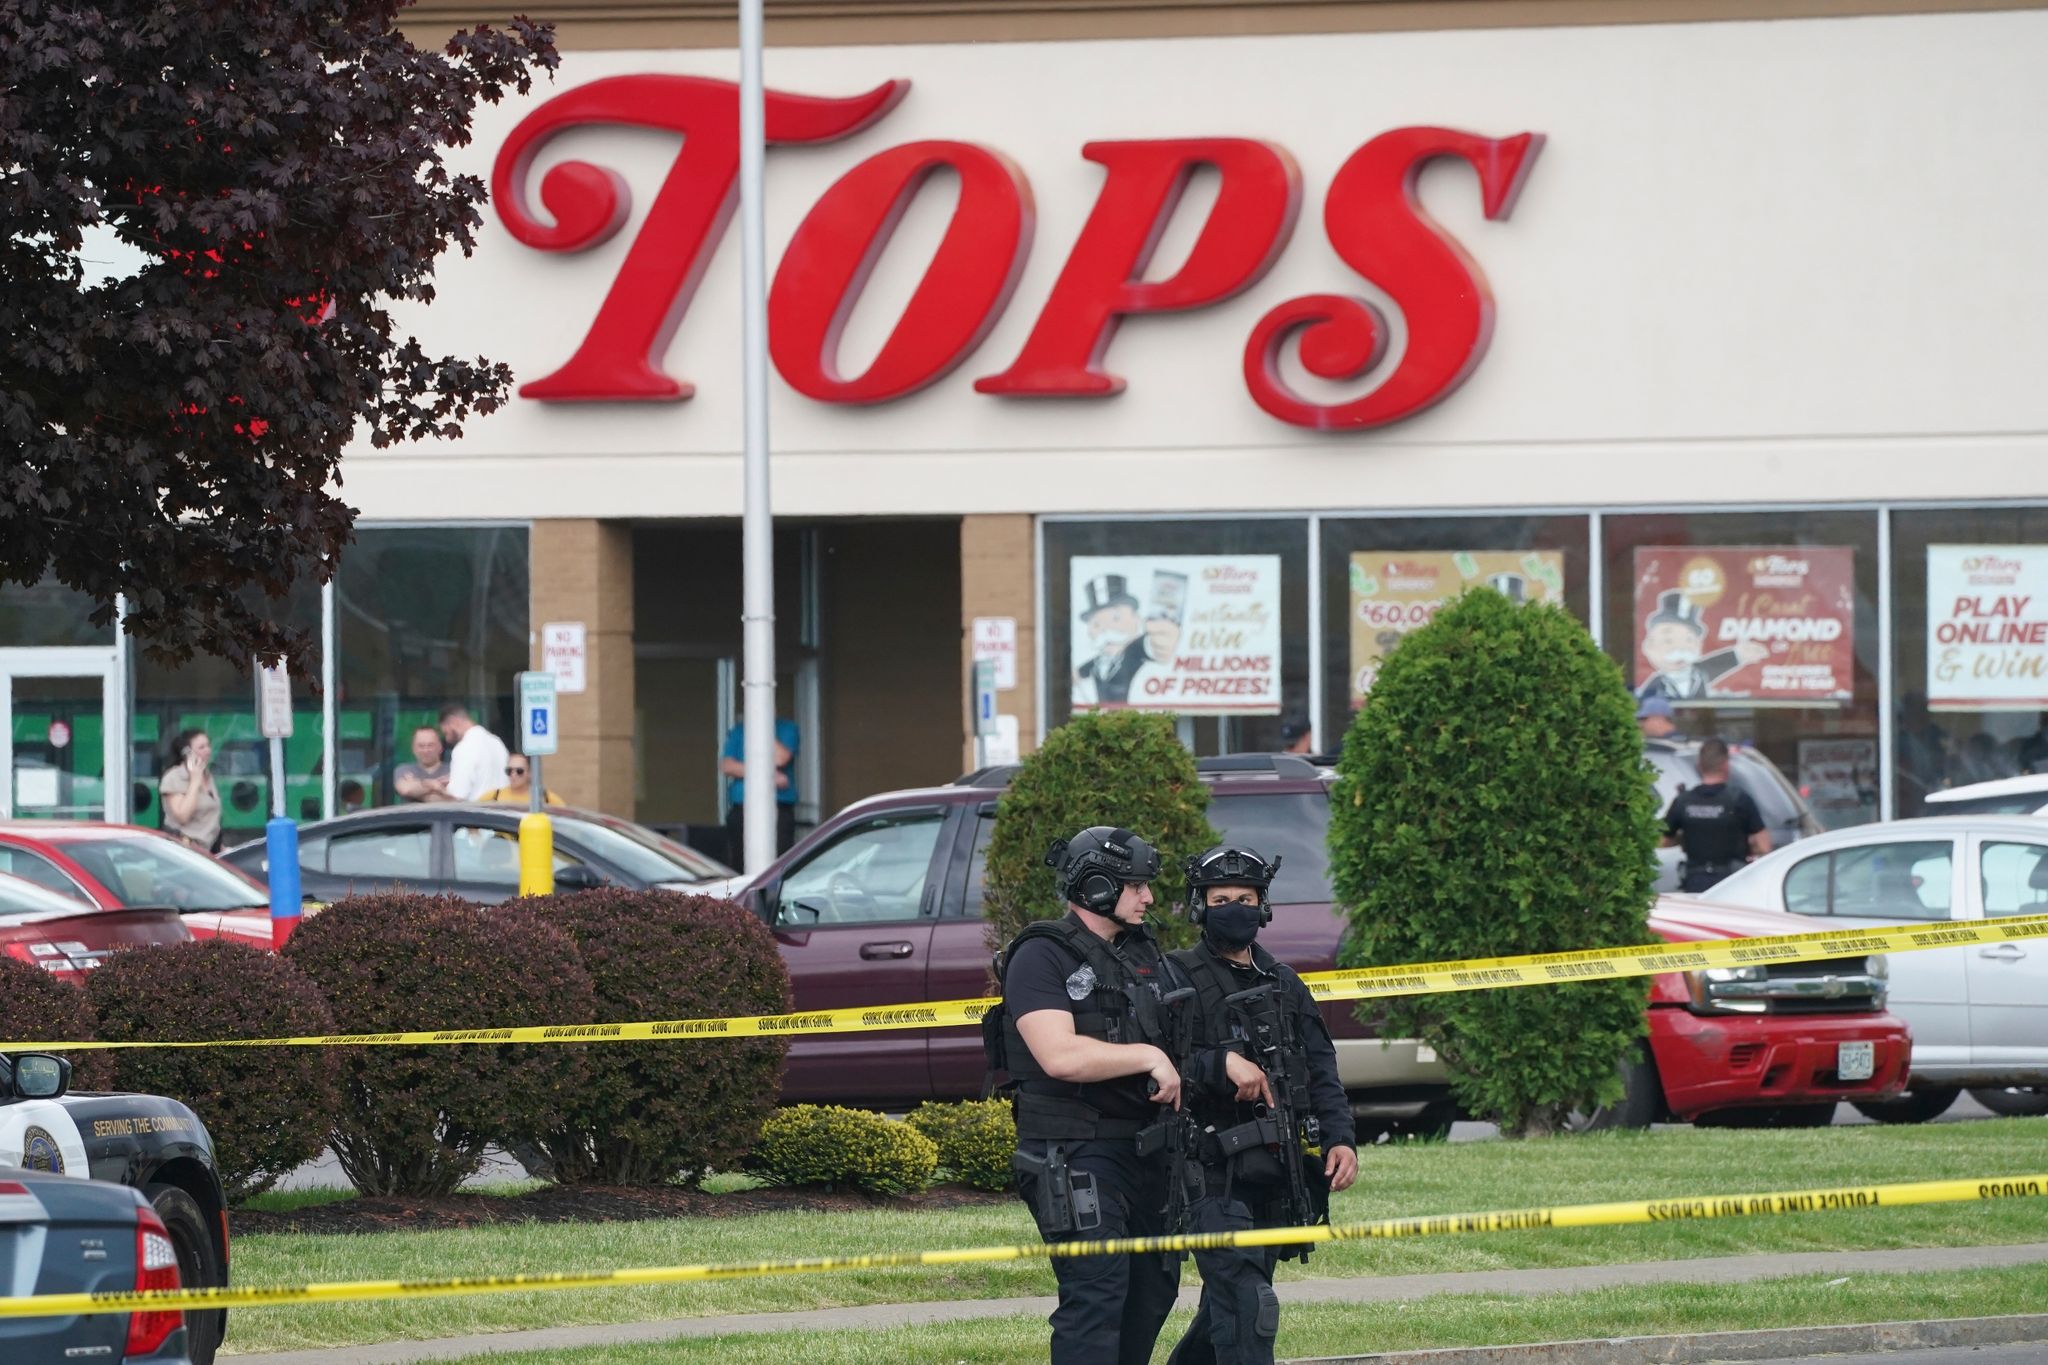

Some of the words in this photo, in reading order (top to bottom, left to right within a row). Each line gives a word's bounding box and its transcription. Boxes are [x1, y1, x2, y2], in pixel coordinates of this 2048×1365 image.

[491, 72, 1547, 433] TOPS
[1953, 596, 2031, 618] PLAY
[1718, 617, 1842, 641] DIAMOND
[1936, 622, 2048, 644] ONLINE
[1173, 655, 1271, 672] MILLIONS
[1144, 677, 1176, 695] OF
[1181, 677, 1271, 695] PRIZES!
[93, 1118, 132, 1137] SERVING
[132, 1117, 152, 1134] THE
